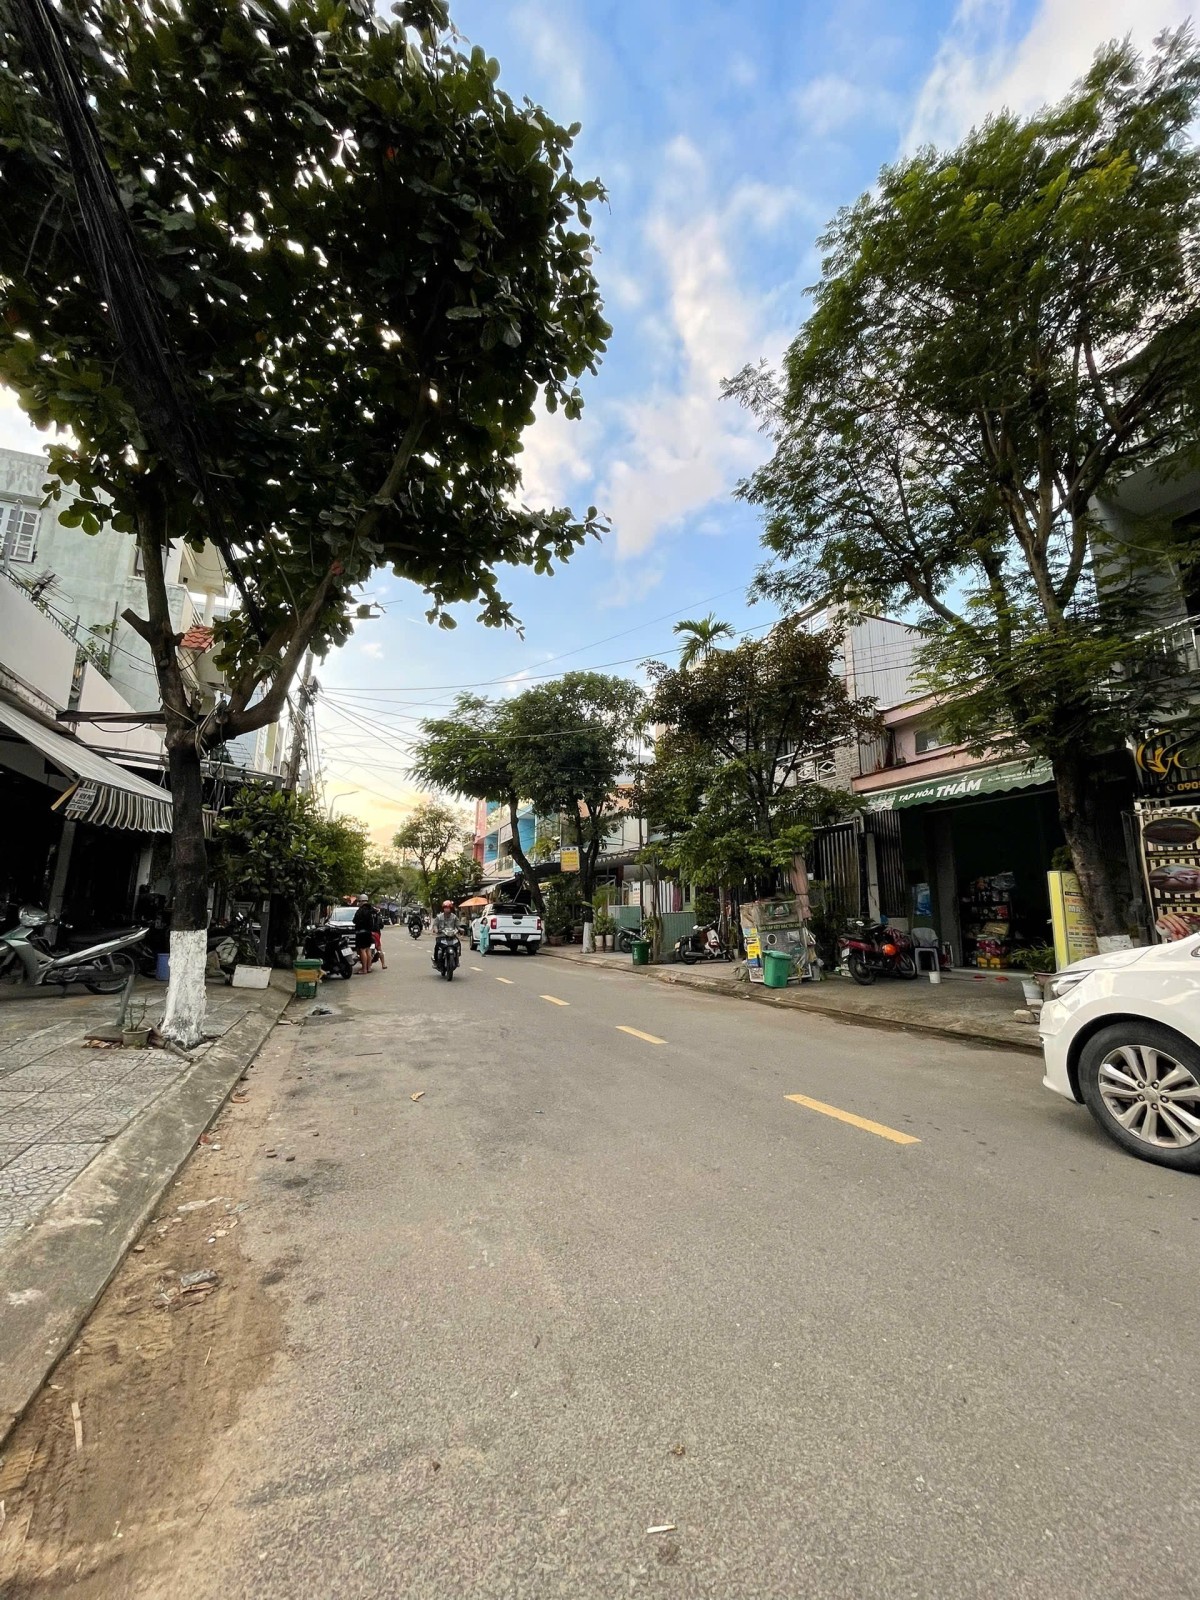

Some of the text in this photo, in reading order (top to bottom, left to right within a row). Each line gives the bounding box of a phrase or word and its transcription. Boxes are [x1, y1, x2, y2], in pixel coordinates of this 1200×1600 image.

[899, 792, 916, 803] TẠP
[915, 788, 934, 799] HÓA
[936, 775, 982, 798] THẮM
[1177, 780, 1200, 791] 090
